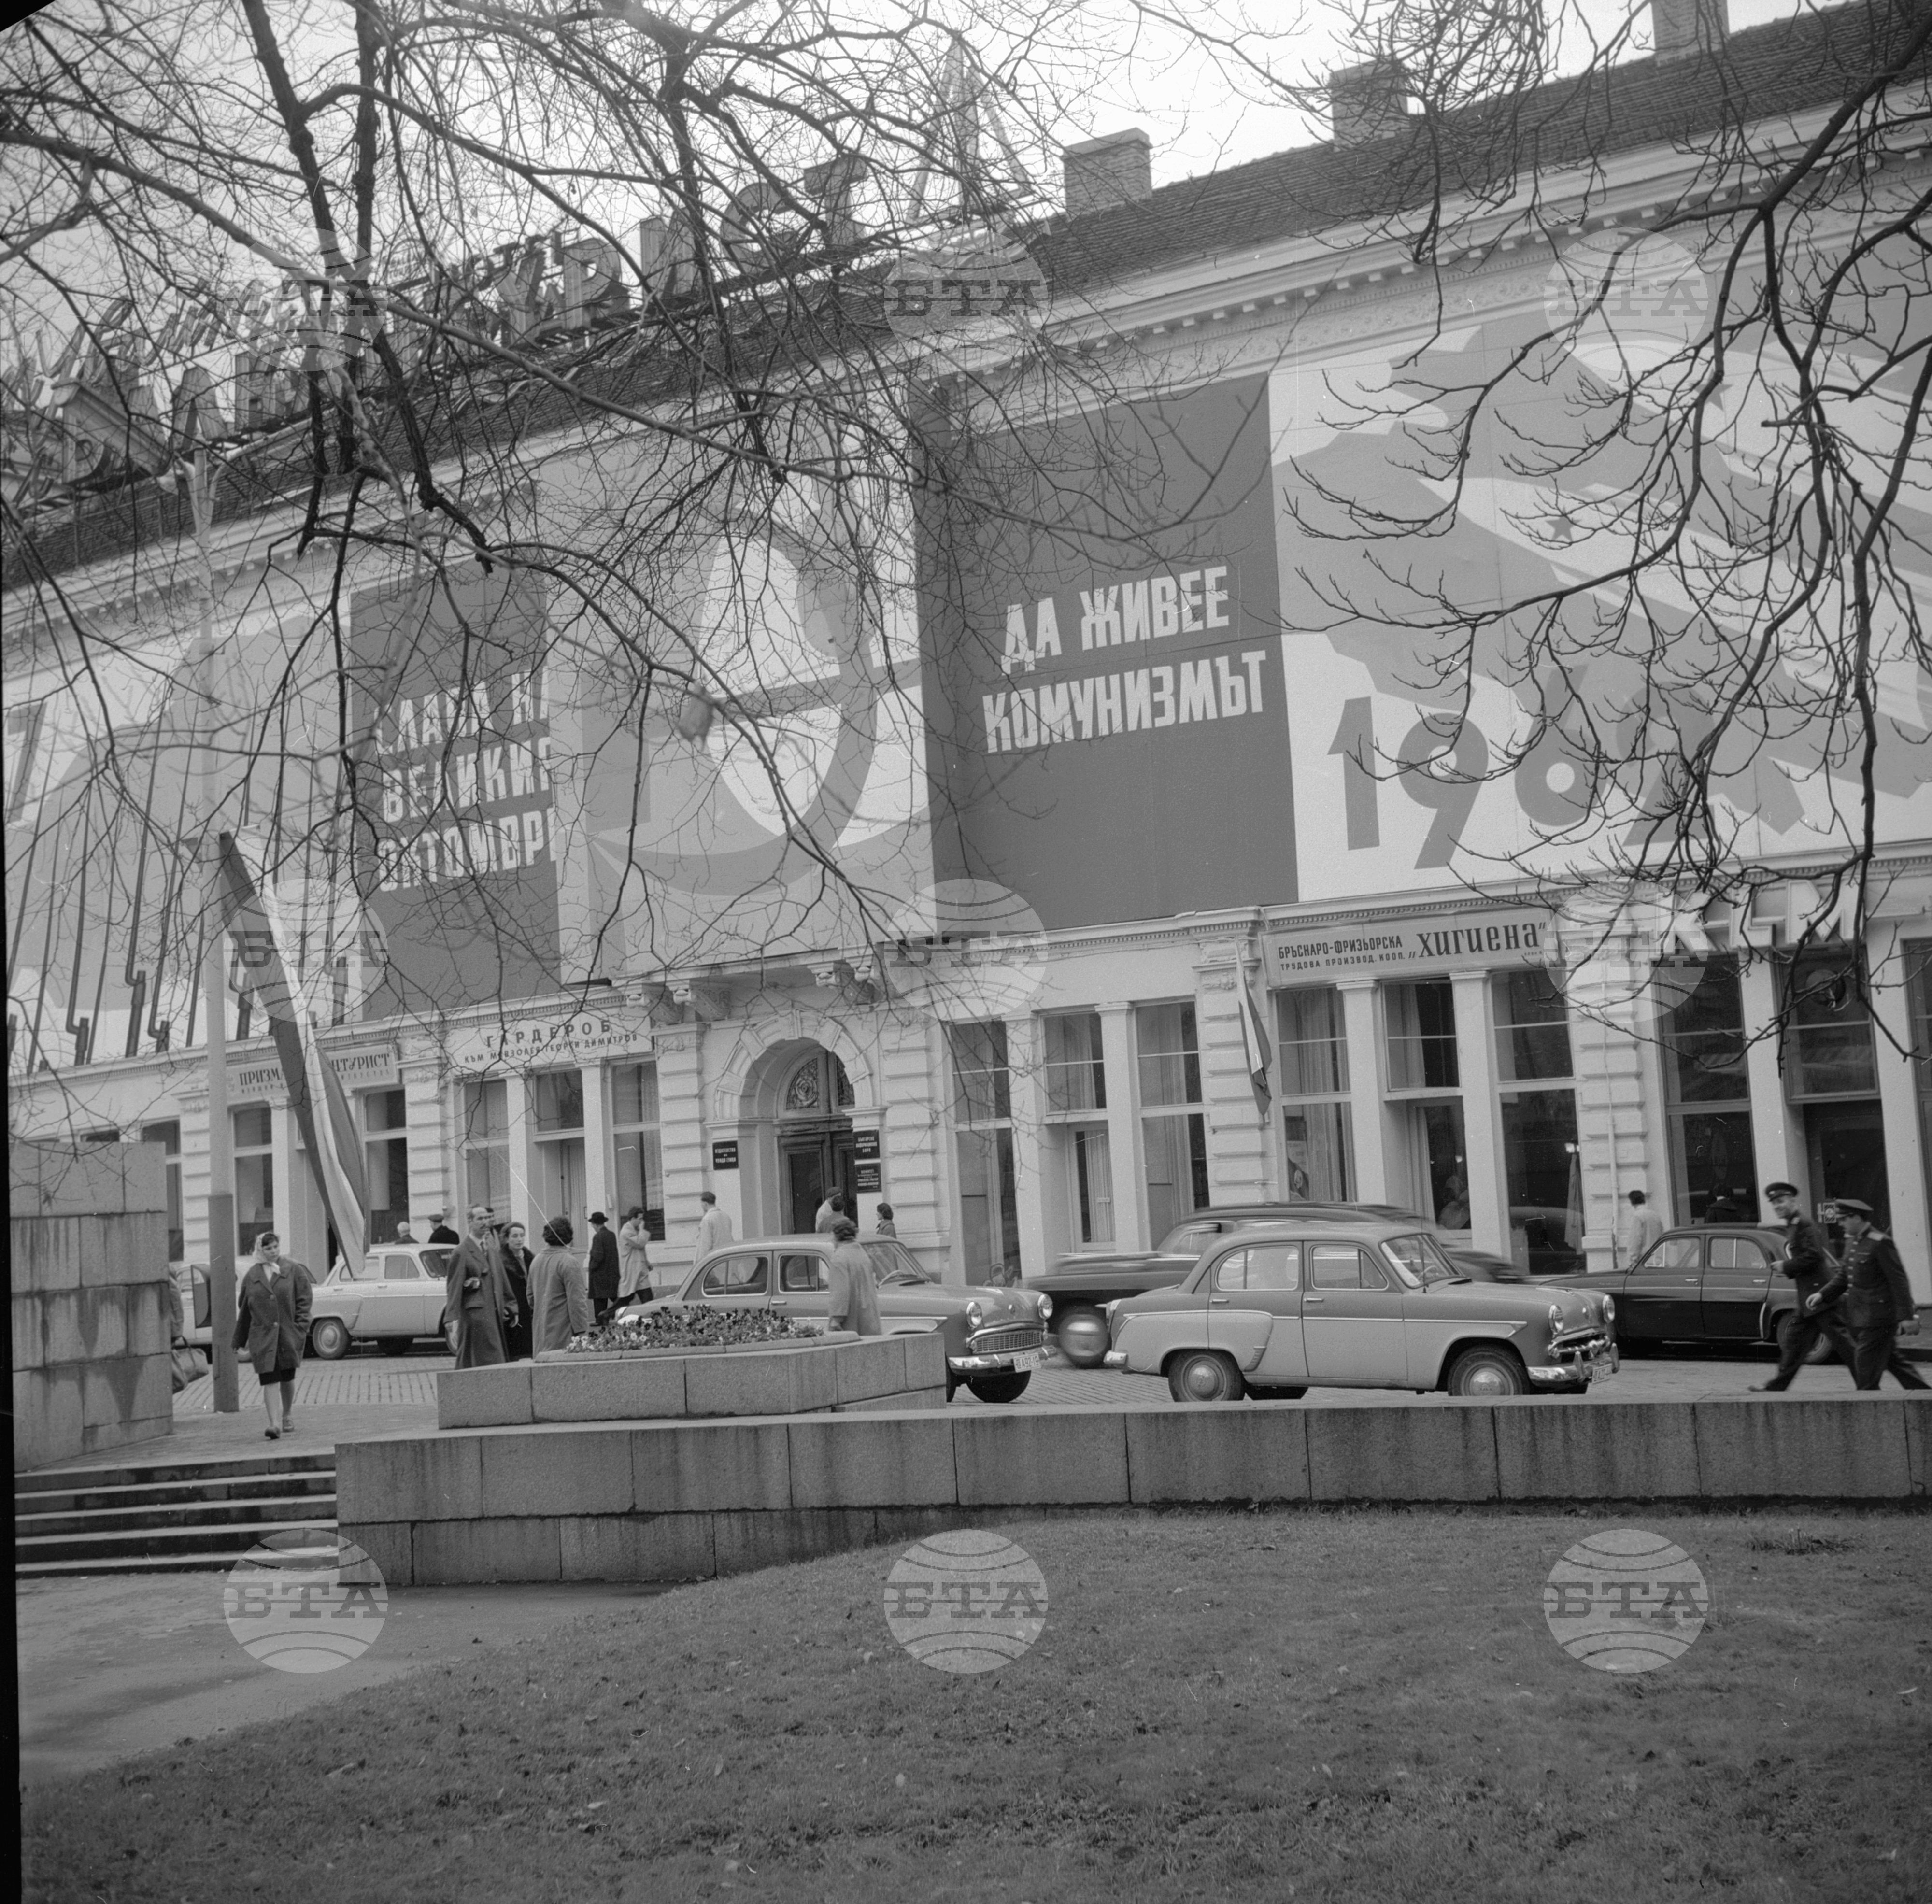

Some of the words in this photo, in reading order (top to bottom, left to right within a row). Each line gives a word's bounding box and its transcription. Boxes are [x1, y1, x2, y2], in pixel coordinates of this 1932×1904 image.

[1001, 597, 1062, 675] ДА
[1080, 566, 1229, 651] ЖИВЕЕ
[982, 650, 1266, 753] КОМУНИЗМЪТ
[1327, 662, 1715, 870] 1962
[1279, 935, 1402, 959] БРЪСНАРО-ФРИЗЬОРСКА
[1280, 960, 1321, 971] ТРУДОВА
[1326, 955, 1377, 967] ПРОИЗВОД.
[1379, 952, 1405, 962] КООП.
[487, 1020, 610, 1048] ГАРДЕРОБ
[465, 1054, 484, 1063] КЪМ
[490, 1046, 540, 1059] МВЗОЛЕЯ
[584, 1034, 637, 1049] ДИМИТРОВ
[239, 1067, 282, 1086] ПРИЗМ
